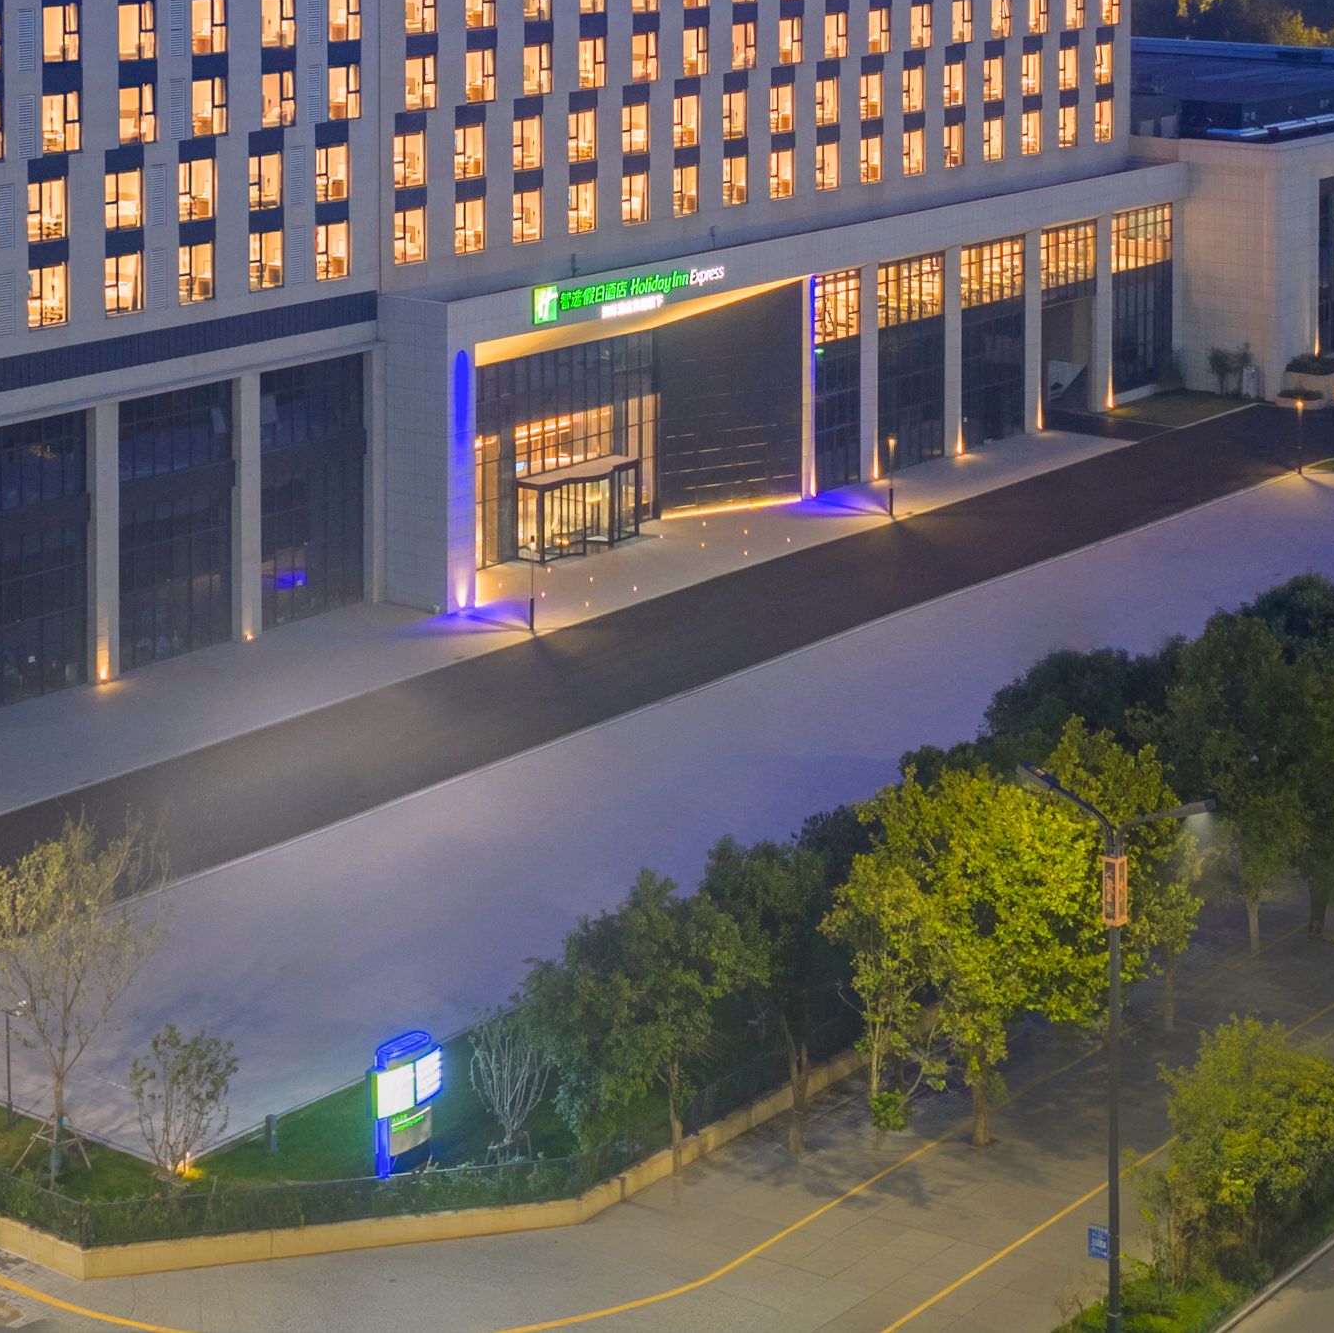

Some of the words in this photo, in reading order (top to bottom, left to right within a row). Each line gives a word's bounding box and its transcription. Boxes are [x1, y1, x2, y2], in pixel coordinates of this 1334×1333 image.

[560, 280, 627, 310] 智选假日酒店
[630, 274, 671, 296] Holiday
[672, 270, 689, 288] Inn
[690, 266, 724, 286] Express
